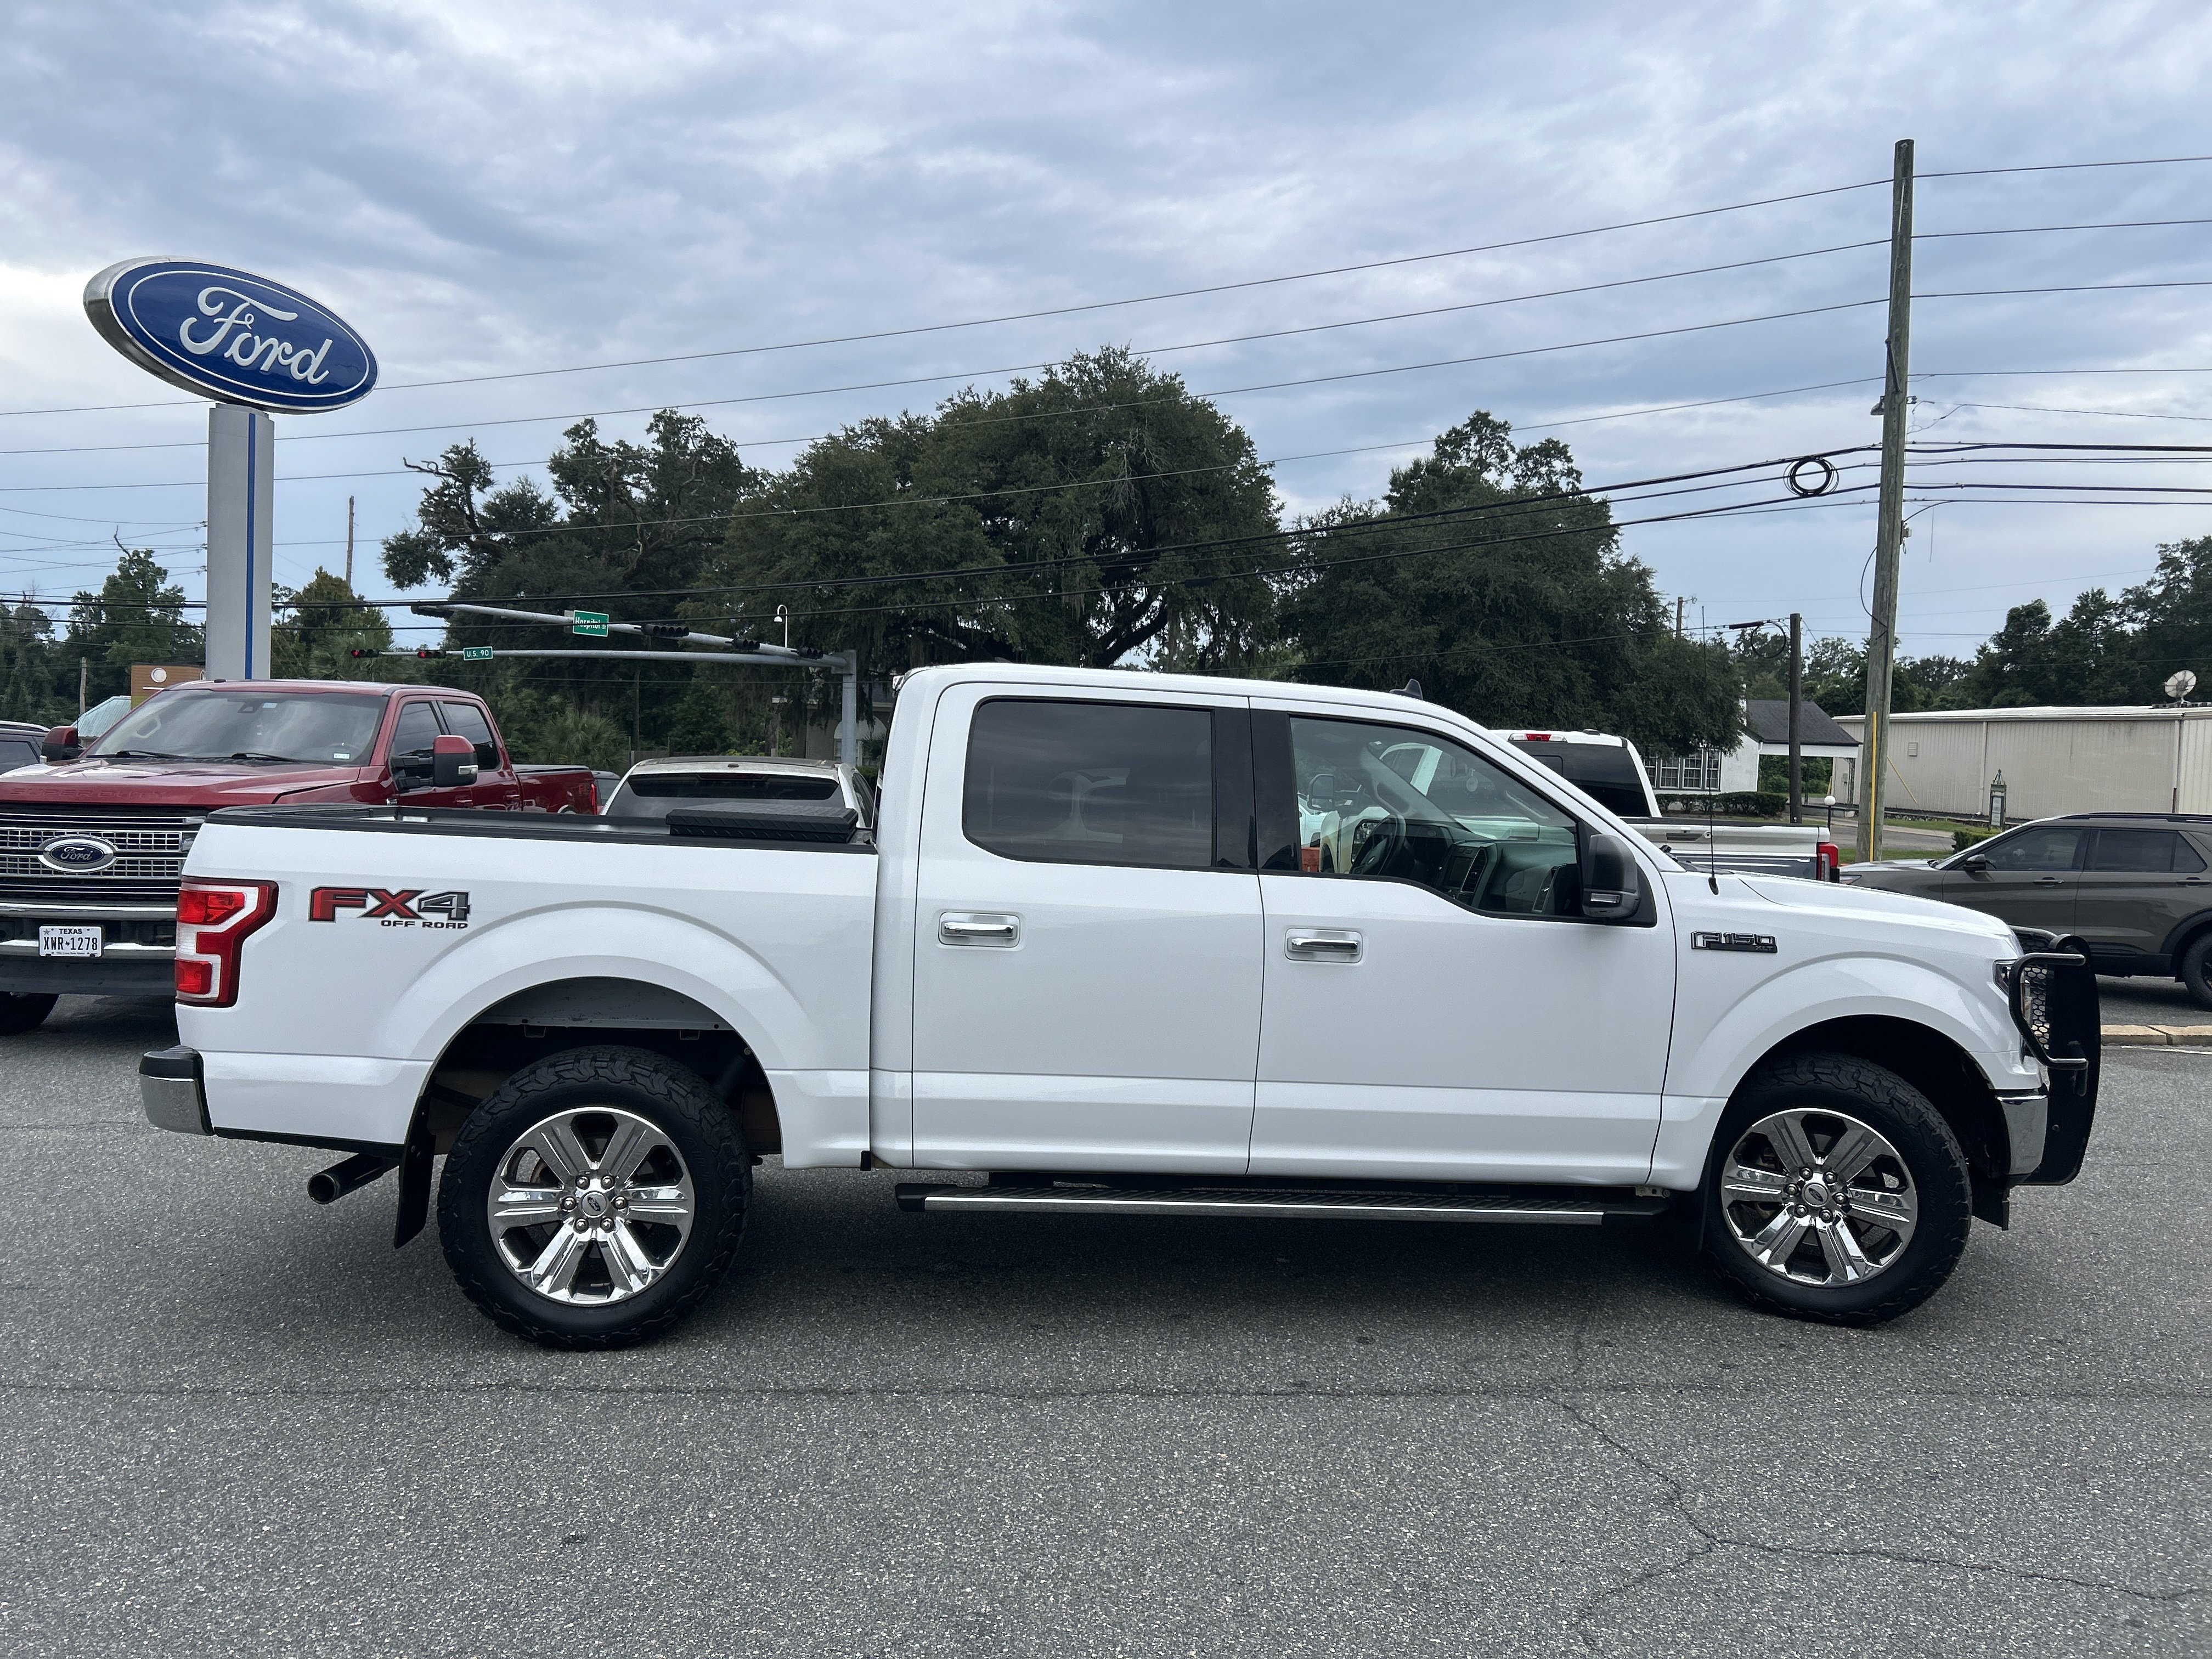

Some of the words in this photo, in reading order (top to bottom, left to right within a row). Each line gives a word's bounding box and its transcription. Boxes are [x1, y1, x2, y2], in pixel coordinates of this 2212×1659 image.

[179, 286, 333, 385] Ford
[575, 616, 601, 630] Hospital
[10, 788, 93, 798] SUPER
[60, 846, 94, 861] Ford
[308, 885, 470, 922] FX4
